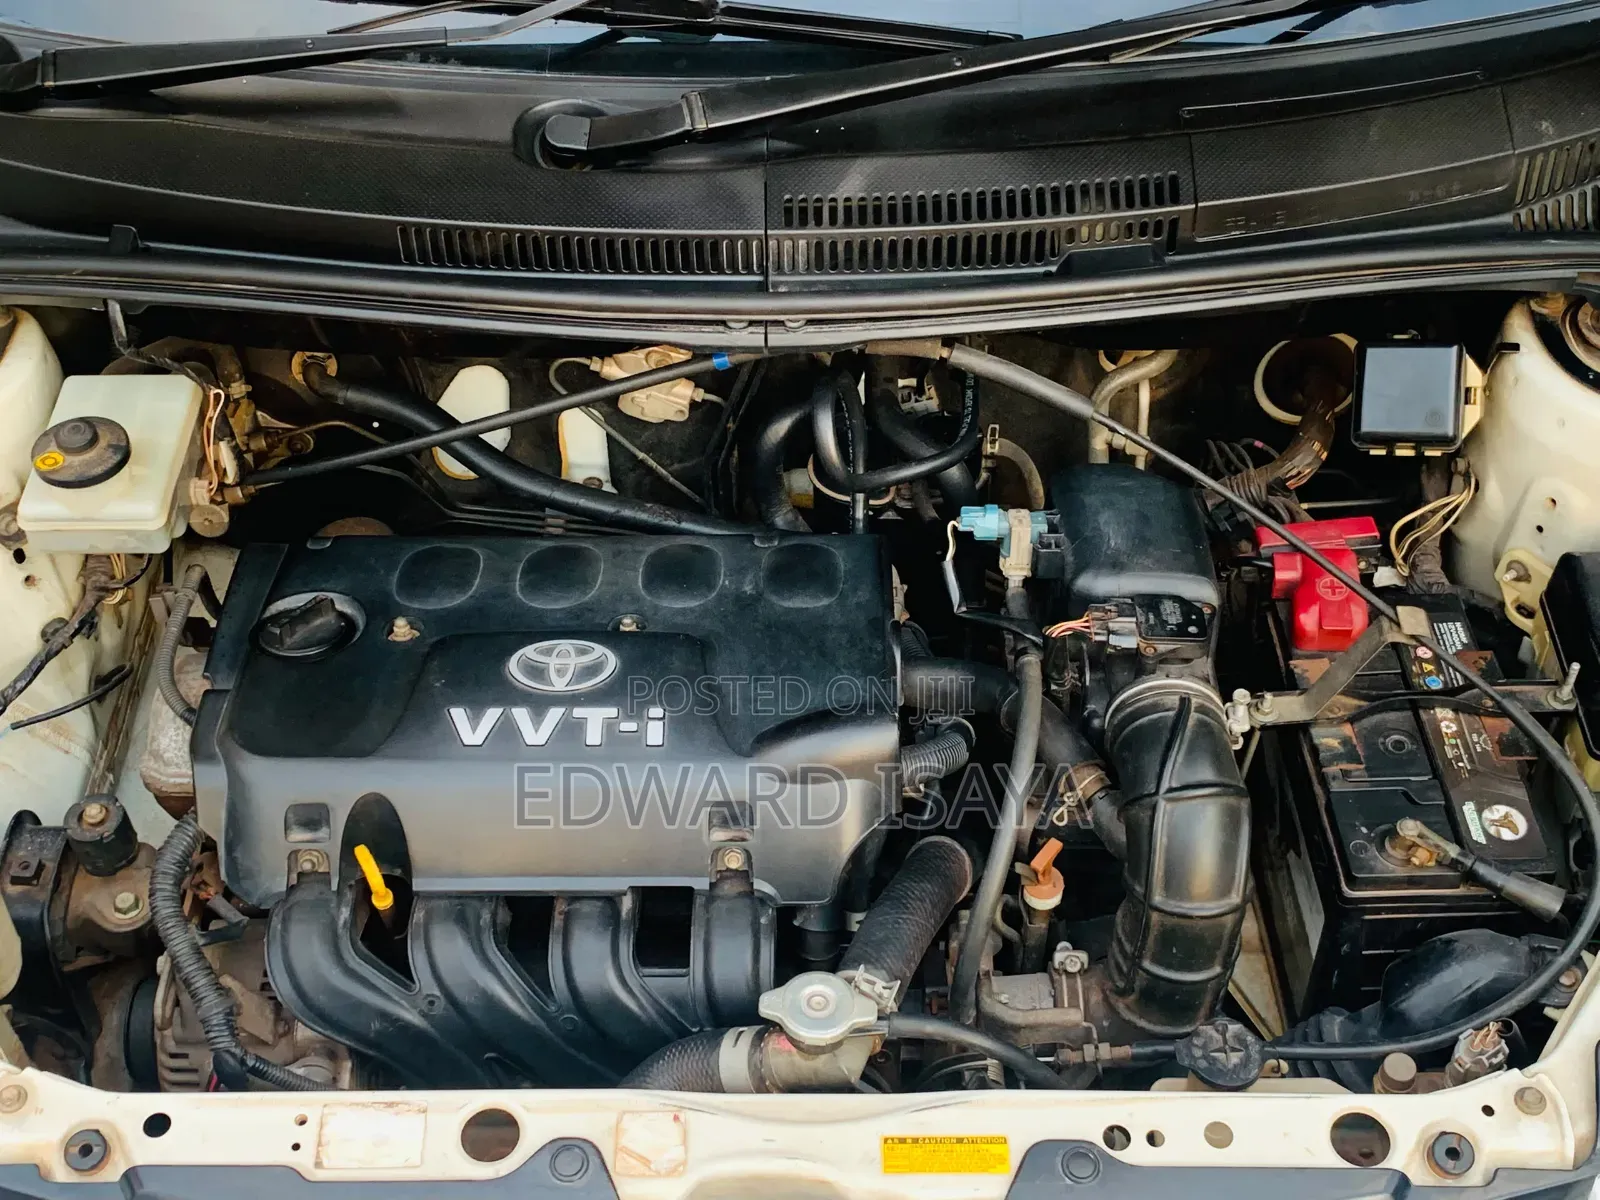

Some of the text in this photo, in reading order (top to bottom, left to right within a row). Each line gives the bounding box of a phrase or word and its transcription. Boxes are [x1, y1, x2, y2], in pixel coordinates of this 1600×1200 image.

[449, 706, 667, 748] VVT-i
[918, 1136, 957, 1144] CAUTION
[962, 1136, 1005, 1144] ATTENTION
